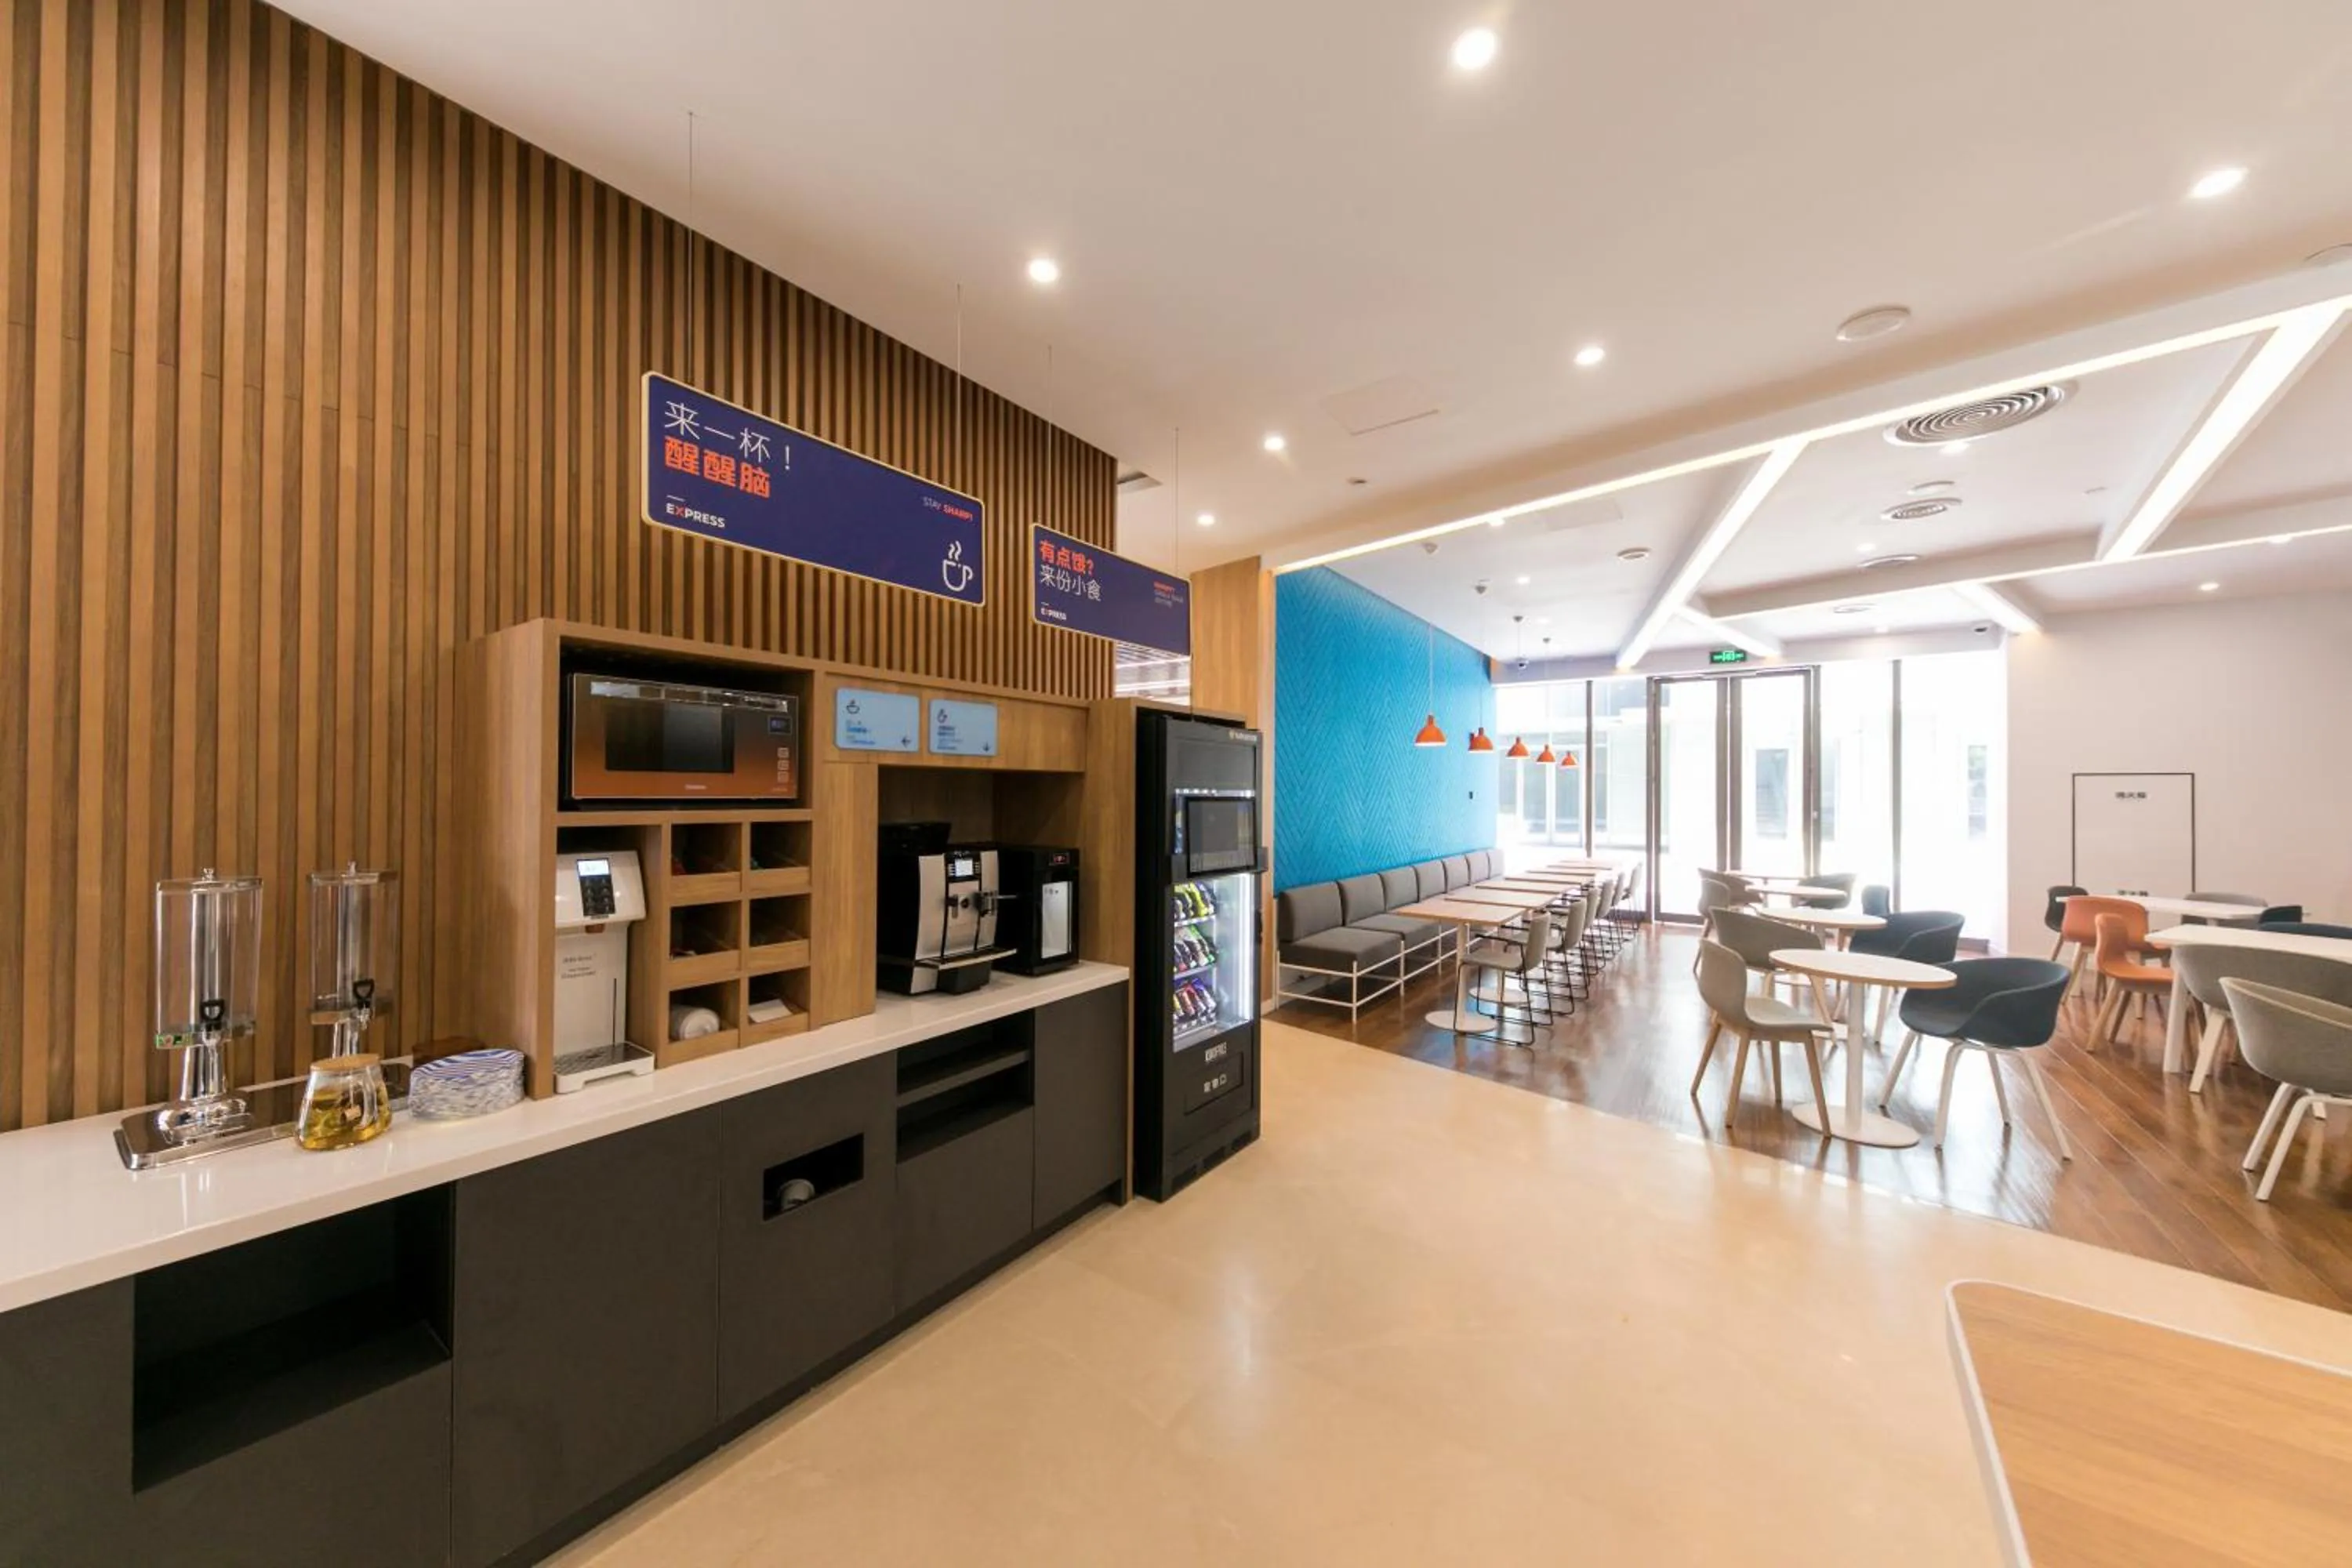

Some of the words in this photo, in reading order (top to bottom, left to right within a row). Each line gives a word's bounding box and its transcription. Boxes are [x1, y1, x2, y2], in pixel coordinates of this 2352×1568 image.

[665, 436, 770, 498] 醒醒脑
[666, 503, 725, 528] EXPRESS
[1041, 564, 1101, 601] 来份小食
